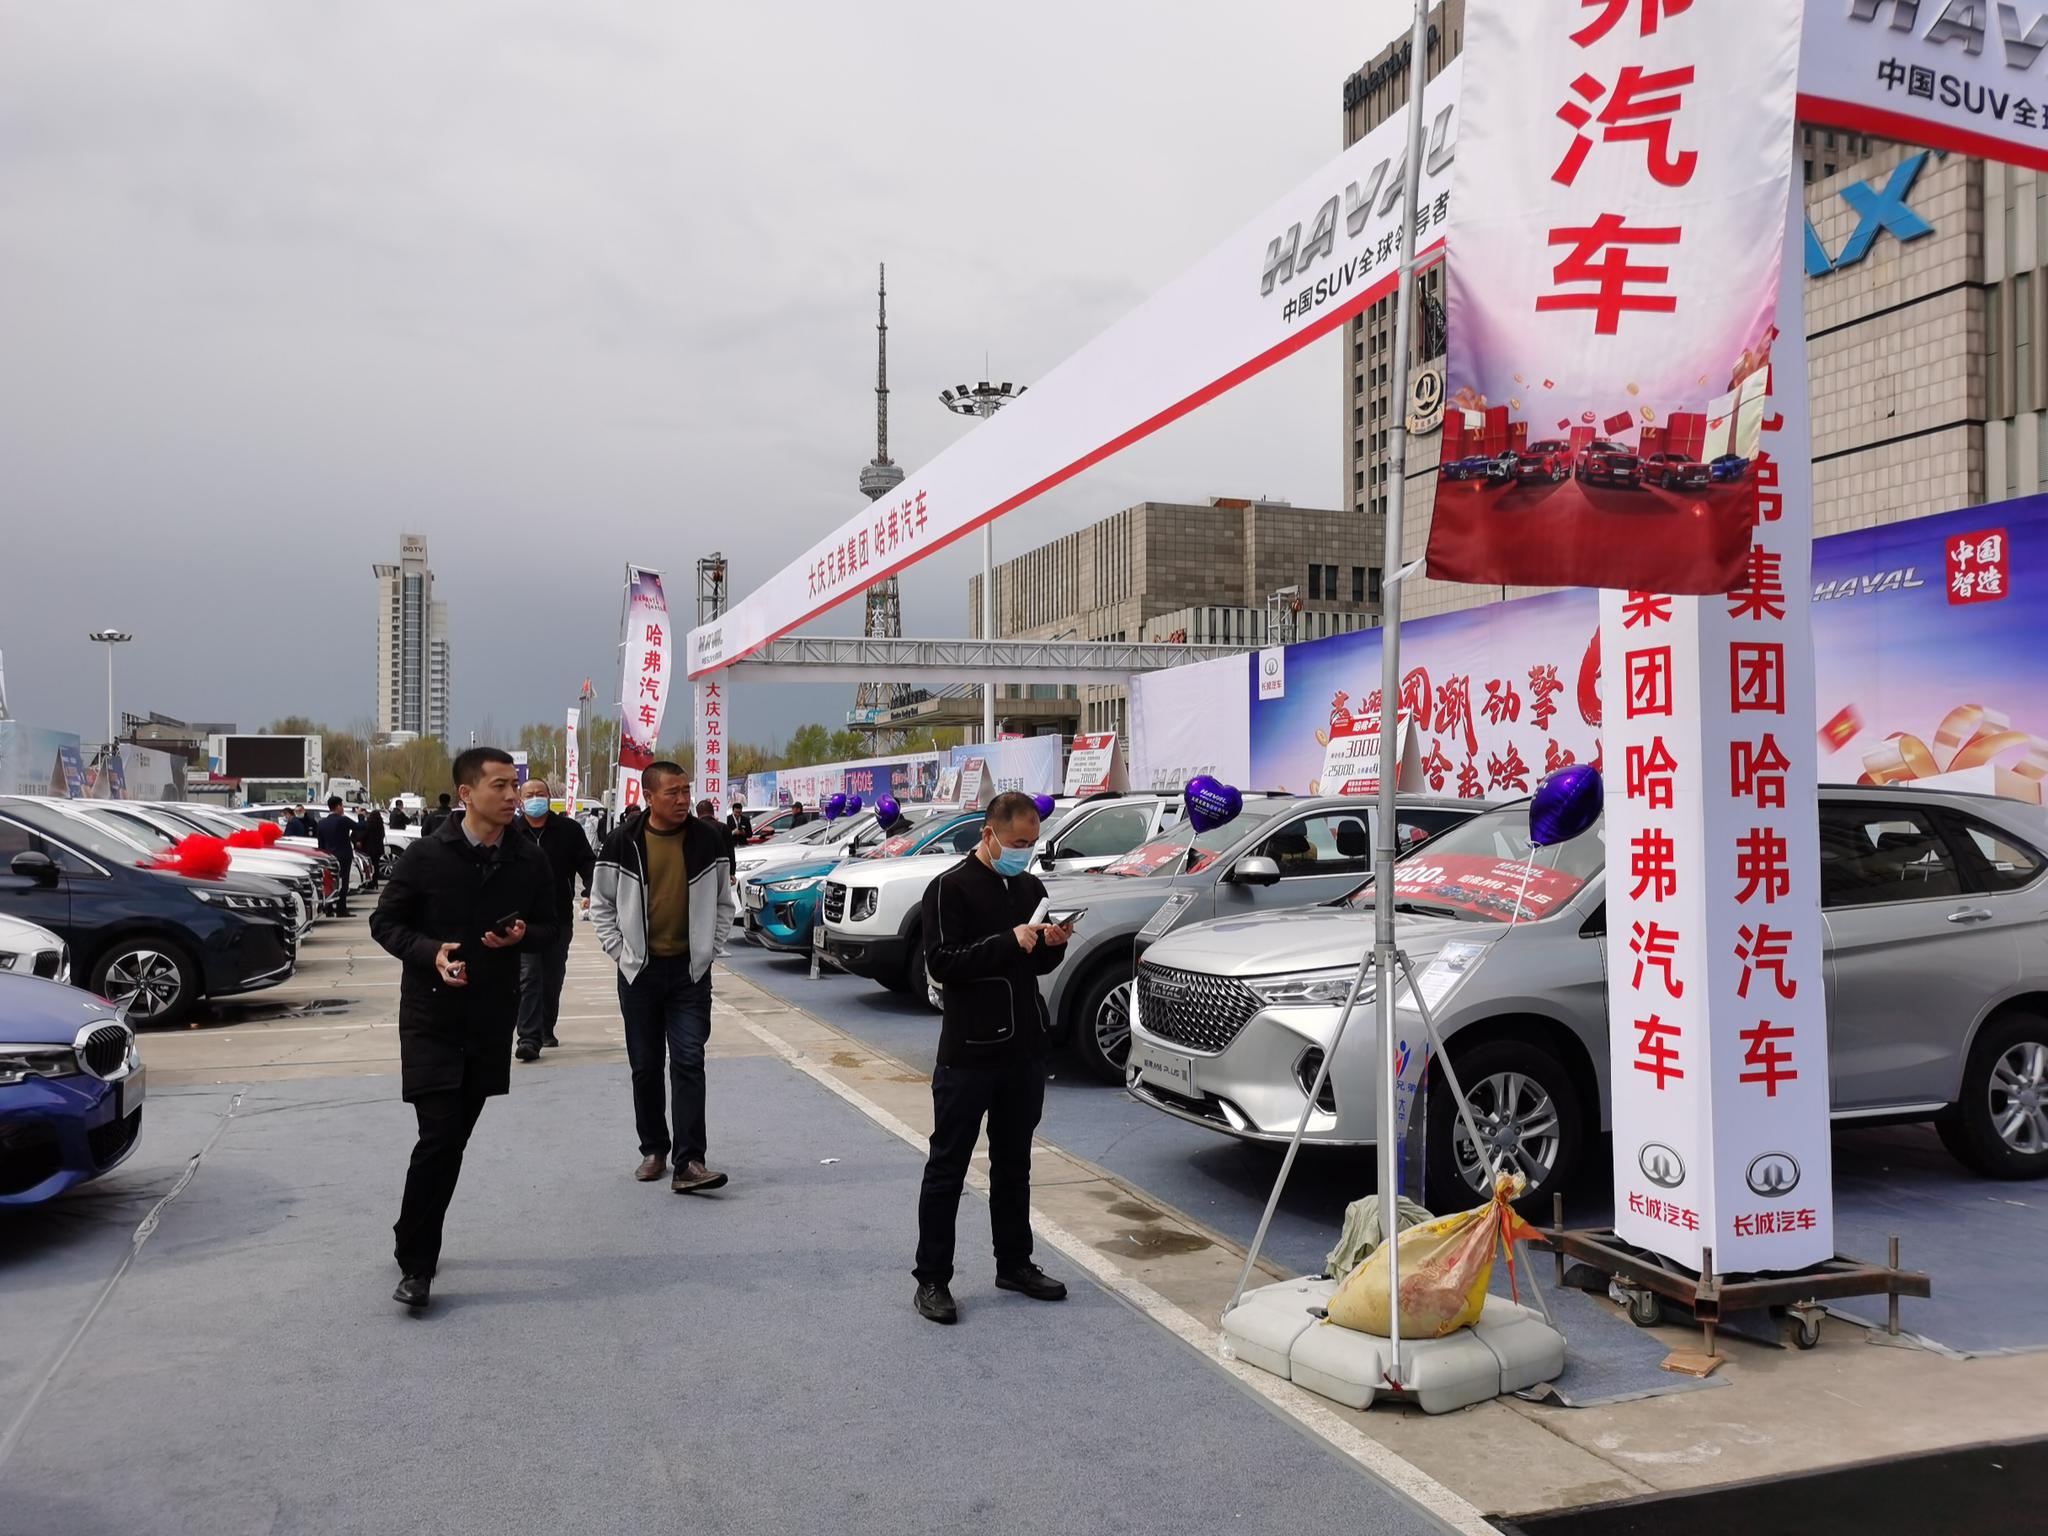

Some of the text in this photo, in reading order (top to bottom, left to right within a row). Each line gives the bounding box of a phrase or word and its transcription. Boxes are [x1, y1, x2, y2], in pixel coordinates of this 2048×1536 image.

[1876, 57, 2048, 130] 中国SUV全
[808, 489, 929, 600] 大庆兄弟集团 哈弗汽车
[1950, 534, 2003, 570] 中国
[1811, 567, 1925, 602] HAVAL
[1951, 565, 2003, 598] 智造
[638, 623, 664, 728] 哈弗汽车
[705, 682, 721, 821] 大庆兄弟集团哈
[1628, 1191, 1700, 1232] 长城汽车
[1733, 1208, 1817, 1237] 长城汽车
